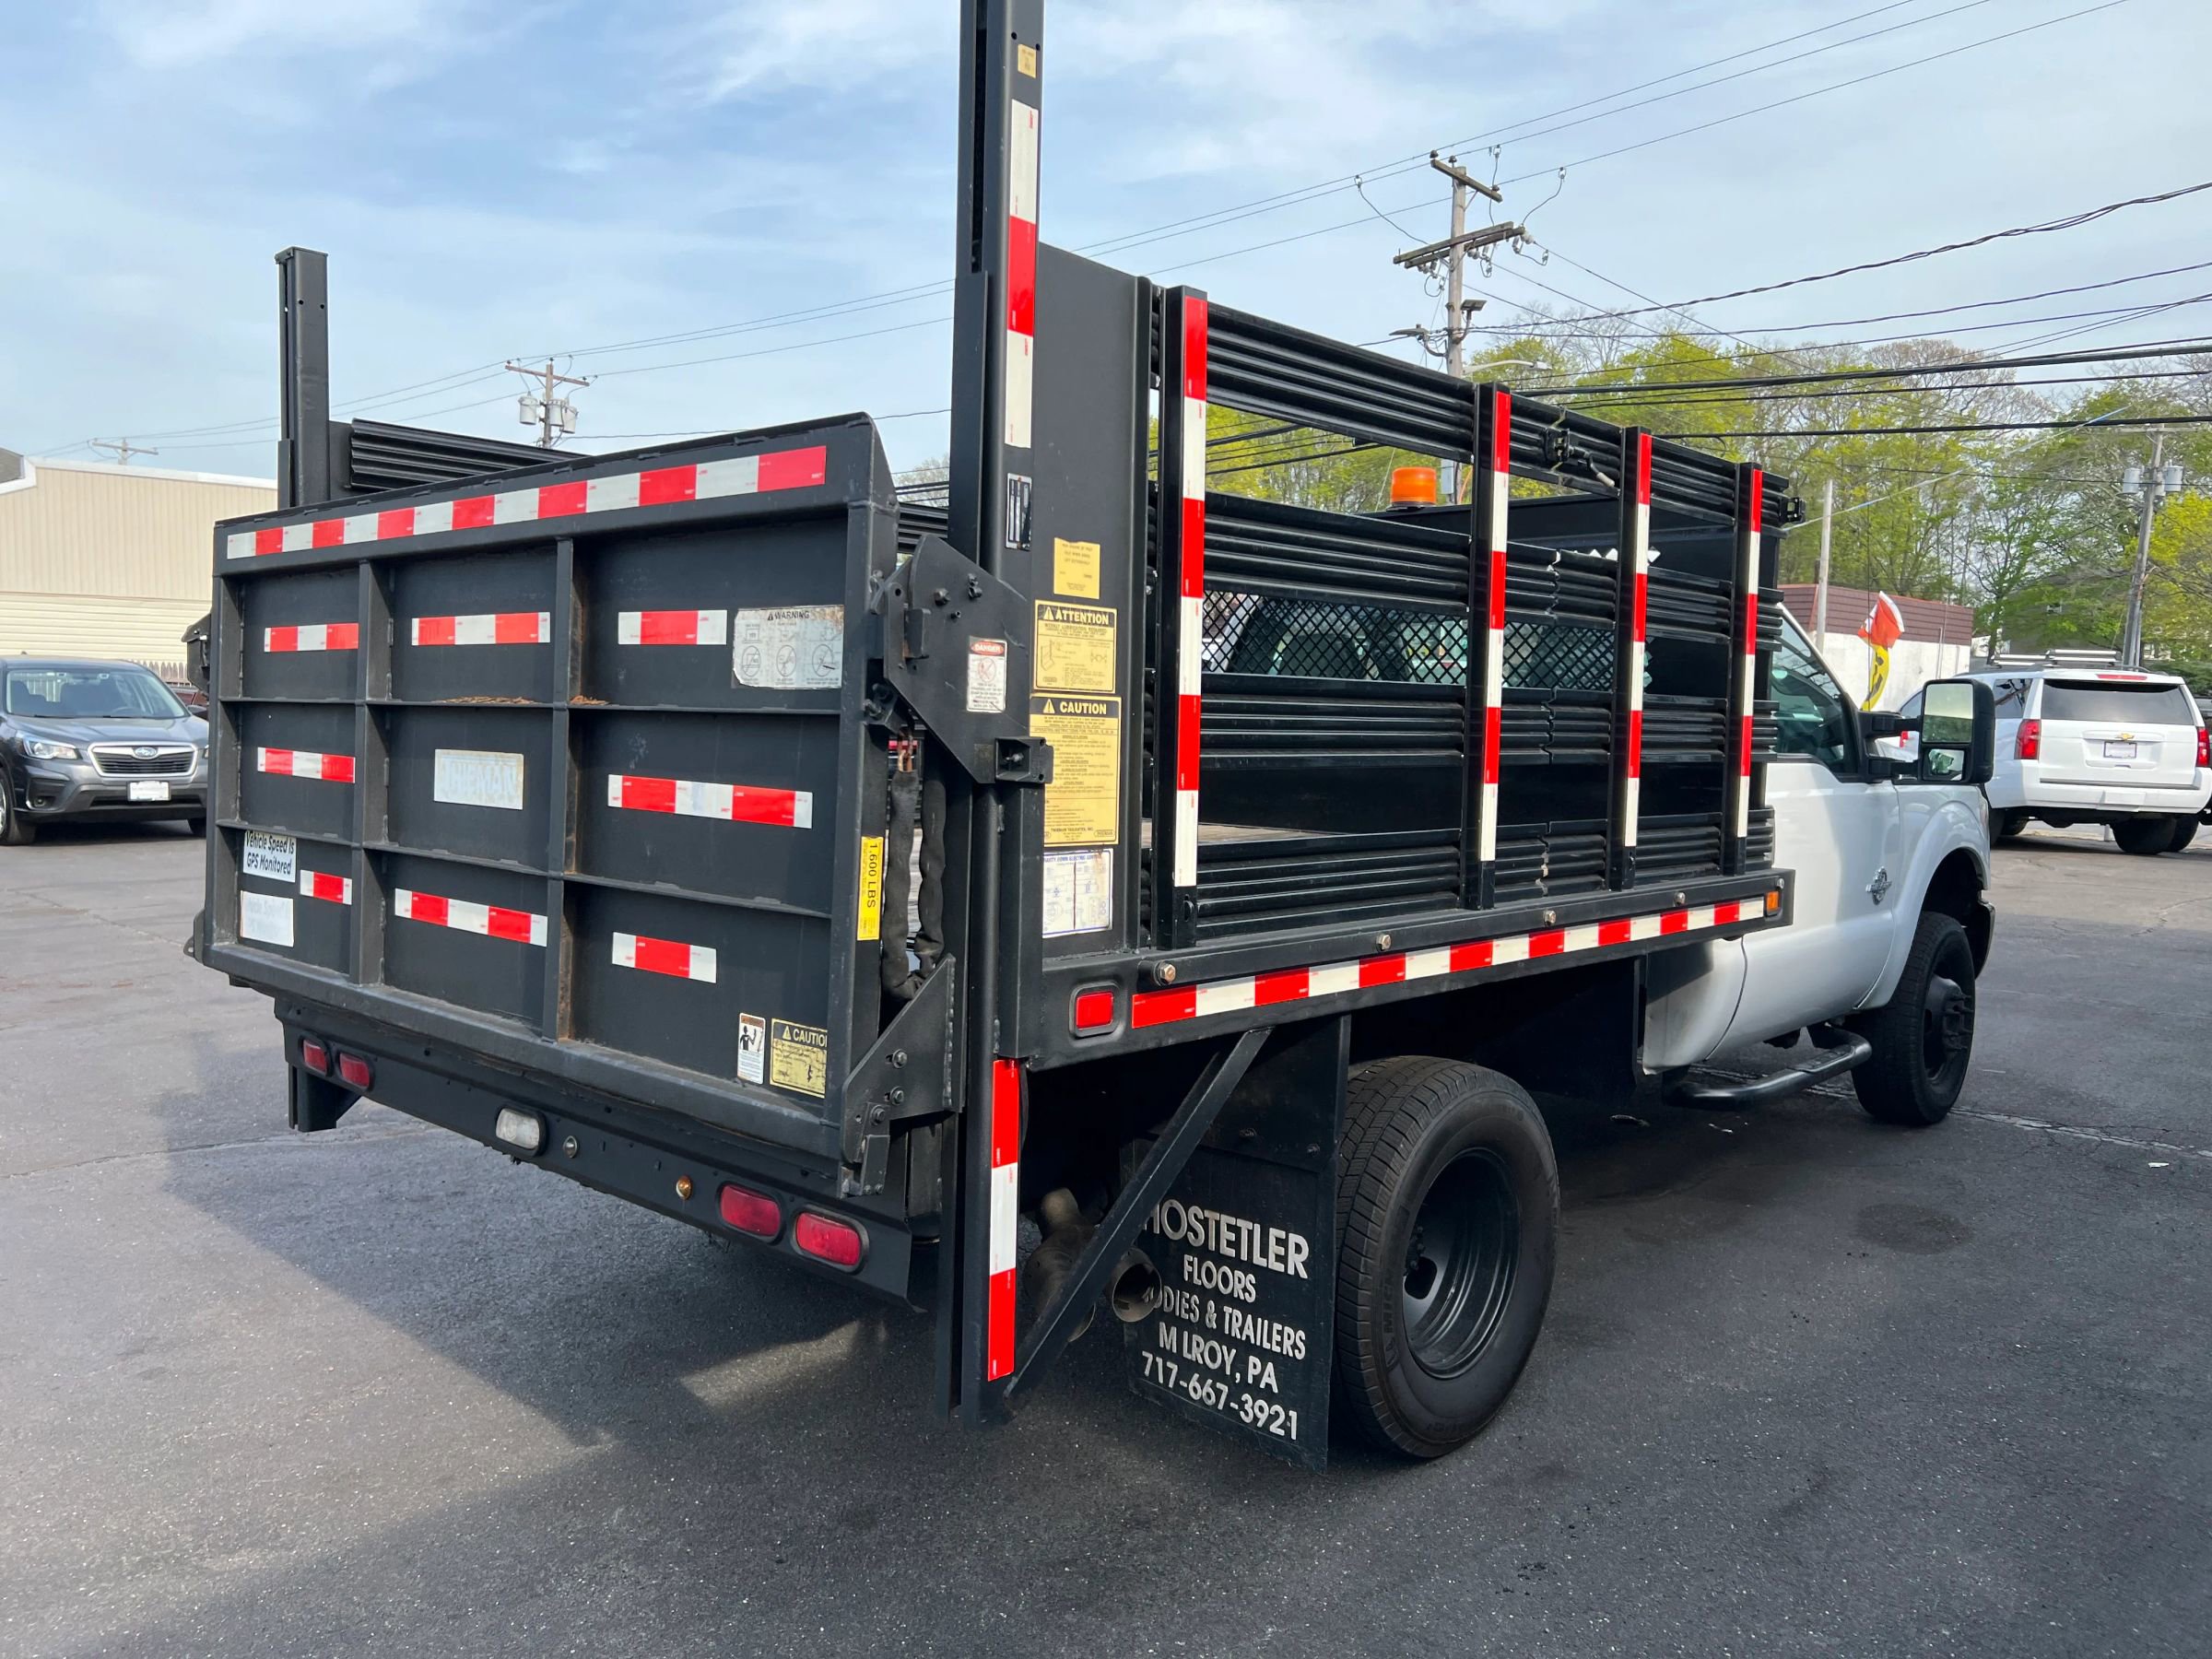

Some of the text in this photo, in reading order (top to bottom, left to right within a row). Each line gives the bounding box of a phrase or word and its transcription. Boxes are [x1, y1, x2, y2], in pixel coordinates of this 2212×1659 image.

[774, 610, 810, 620] WARNING
[1055, 608, 1109, 625] ATTENTION
[1059, 700, 1107, 715] CAUTION
[246, 830, 267, 850] Vehicle
[268, 834, 288, 854] Speed
[247, 852, 292, 875] GPS Monitored
[867, 842, 878, 877] 1,600
[866, 881, 877, 908] LBS
[793, 1028, 828, 1048] CAUTIO
[1183, 1253, 1256, 1303] FLOORS
[1205, 1300, 1218, 1330] &
[1223, 1305, 1306, 1360] TRAILERS
[1247, 1355, 1279, 1394] PA
[1142, 1350, 1298, 1441] 717-667-3921
